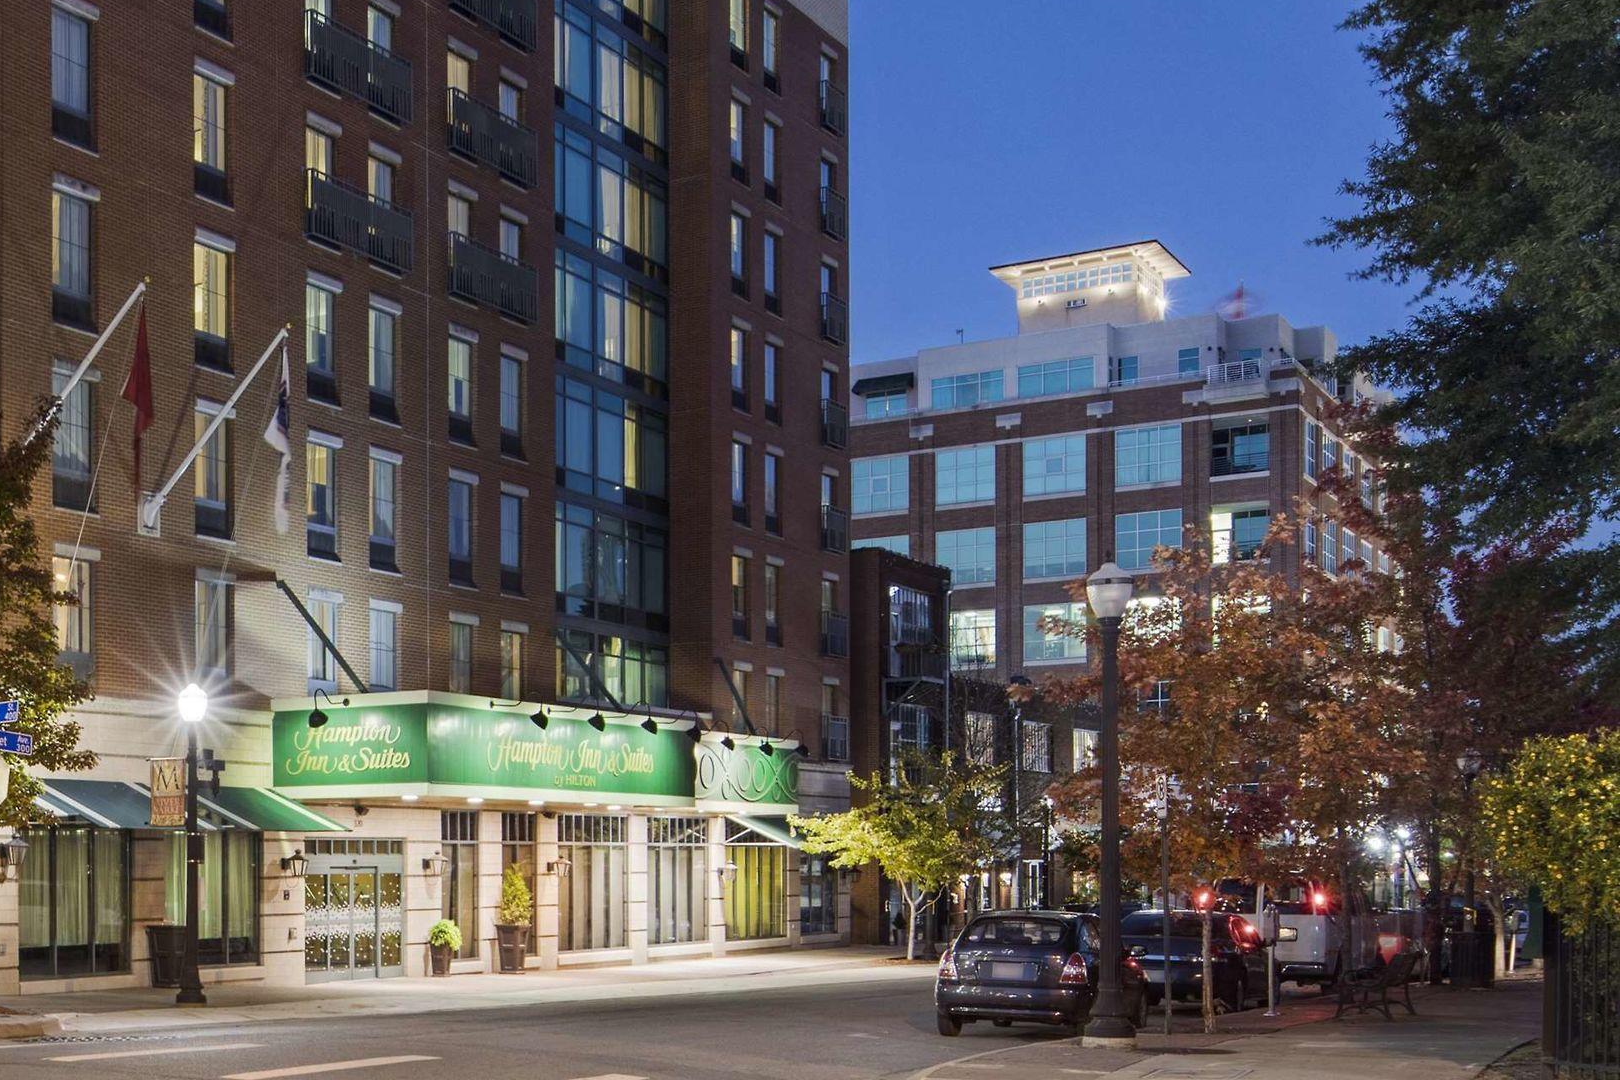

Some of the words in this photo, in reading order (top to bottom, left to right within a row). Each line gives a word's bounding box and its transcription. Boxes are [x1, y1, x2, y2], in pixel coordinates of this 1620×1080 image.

[4, 711, 18, 720] 400
[294, 721, 401, 751] Hampton
[16, 744, 30, 753] 300
[487, 734, 570, 772] Hampton
[570, 739, 608, 774] Inn
[608, 754, 619, 777] &
[616, 743, 654, 774] Suites
[286, 750, 338, 776] Inn
[338, 754, 354, 774] &
[351, 747, 411, 772] Suites
[565, 775, 597, 788] HILTON
